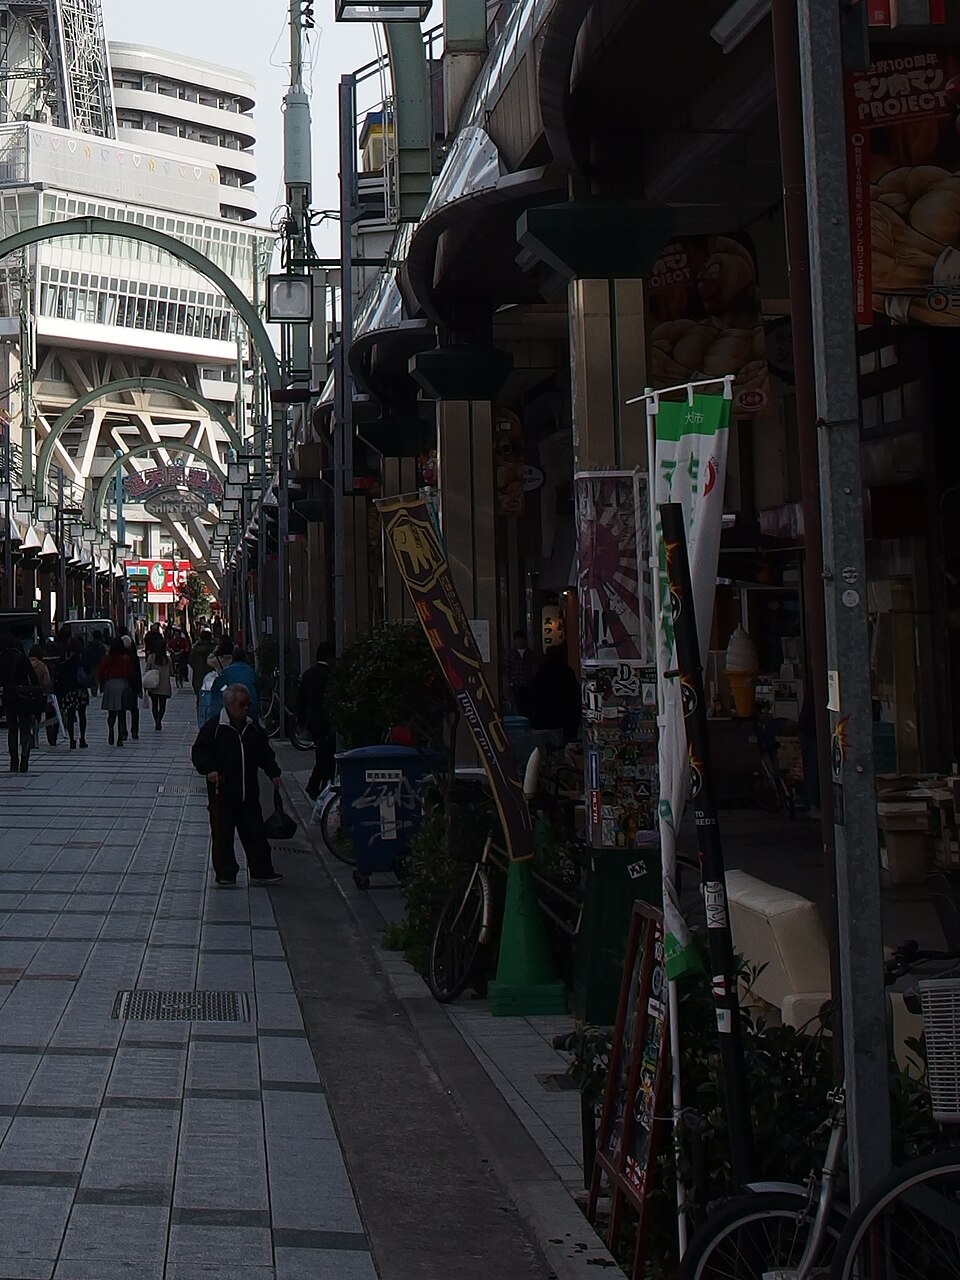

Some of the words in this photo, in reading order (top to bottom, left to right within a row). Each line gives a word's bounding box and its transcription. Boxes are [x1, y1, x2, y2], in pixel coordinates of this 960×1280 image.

[853, 68, 944, 101] キン肉マン
[857, 91, 947, 120] PROJECT
